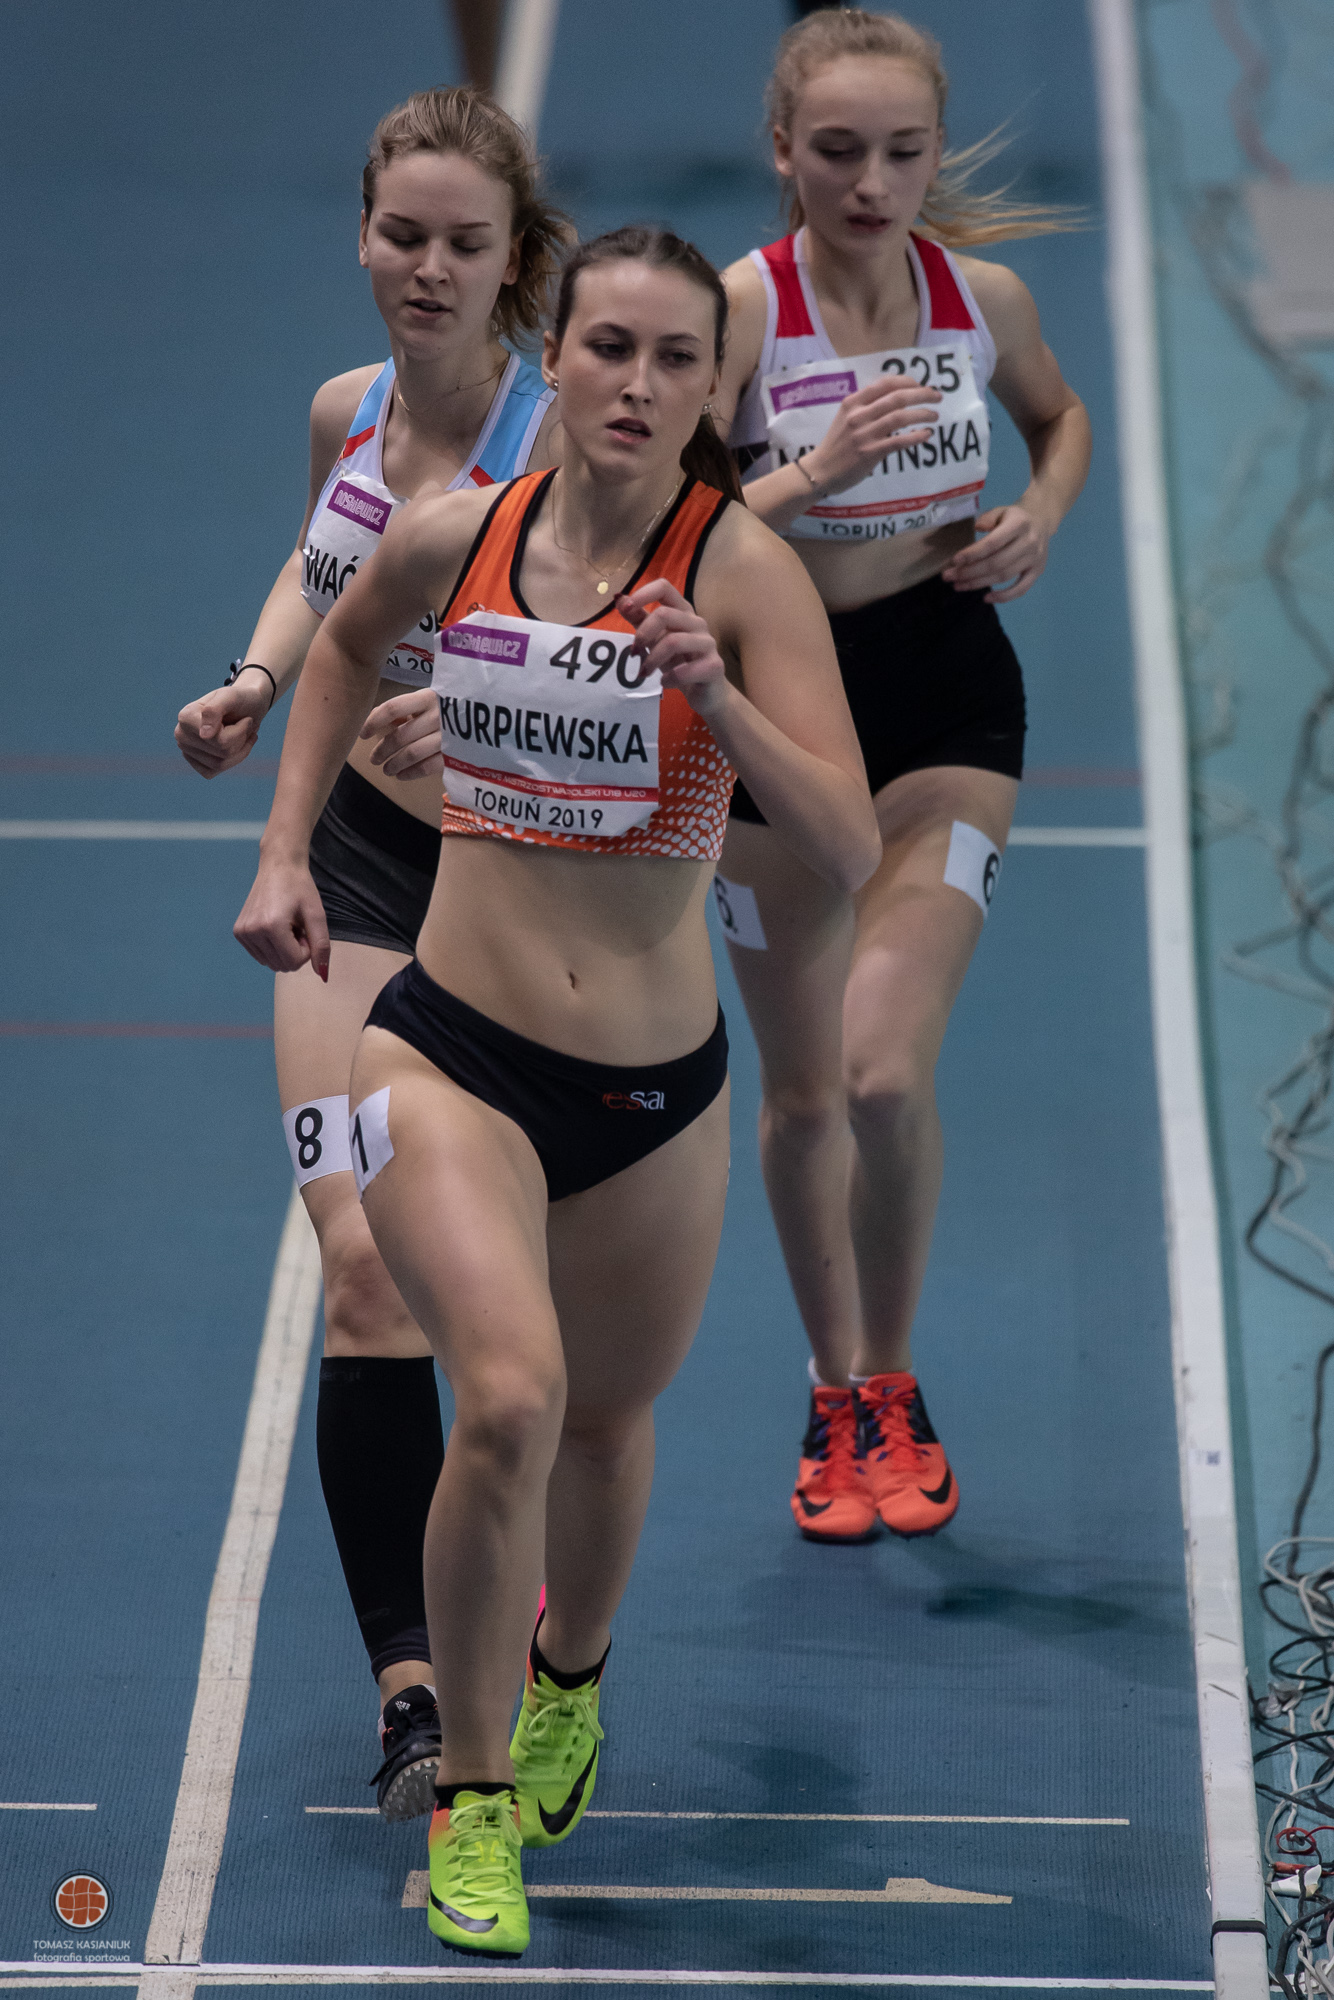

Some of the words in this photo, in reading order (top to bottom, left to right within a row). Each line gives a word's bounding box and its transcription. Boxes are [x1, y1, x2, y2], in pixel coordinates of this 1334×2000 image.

[549, 636, 648, 689] 490
[439, 696, 649, 764] KURPIEWSKA
[474, 786, 541, 823] TORUŃ
[547, 806, 604, 830] 2019
[294, 1106, 324, 1170] 8
[351, 1112, 370, 1175] 1
